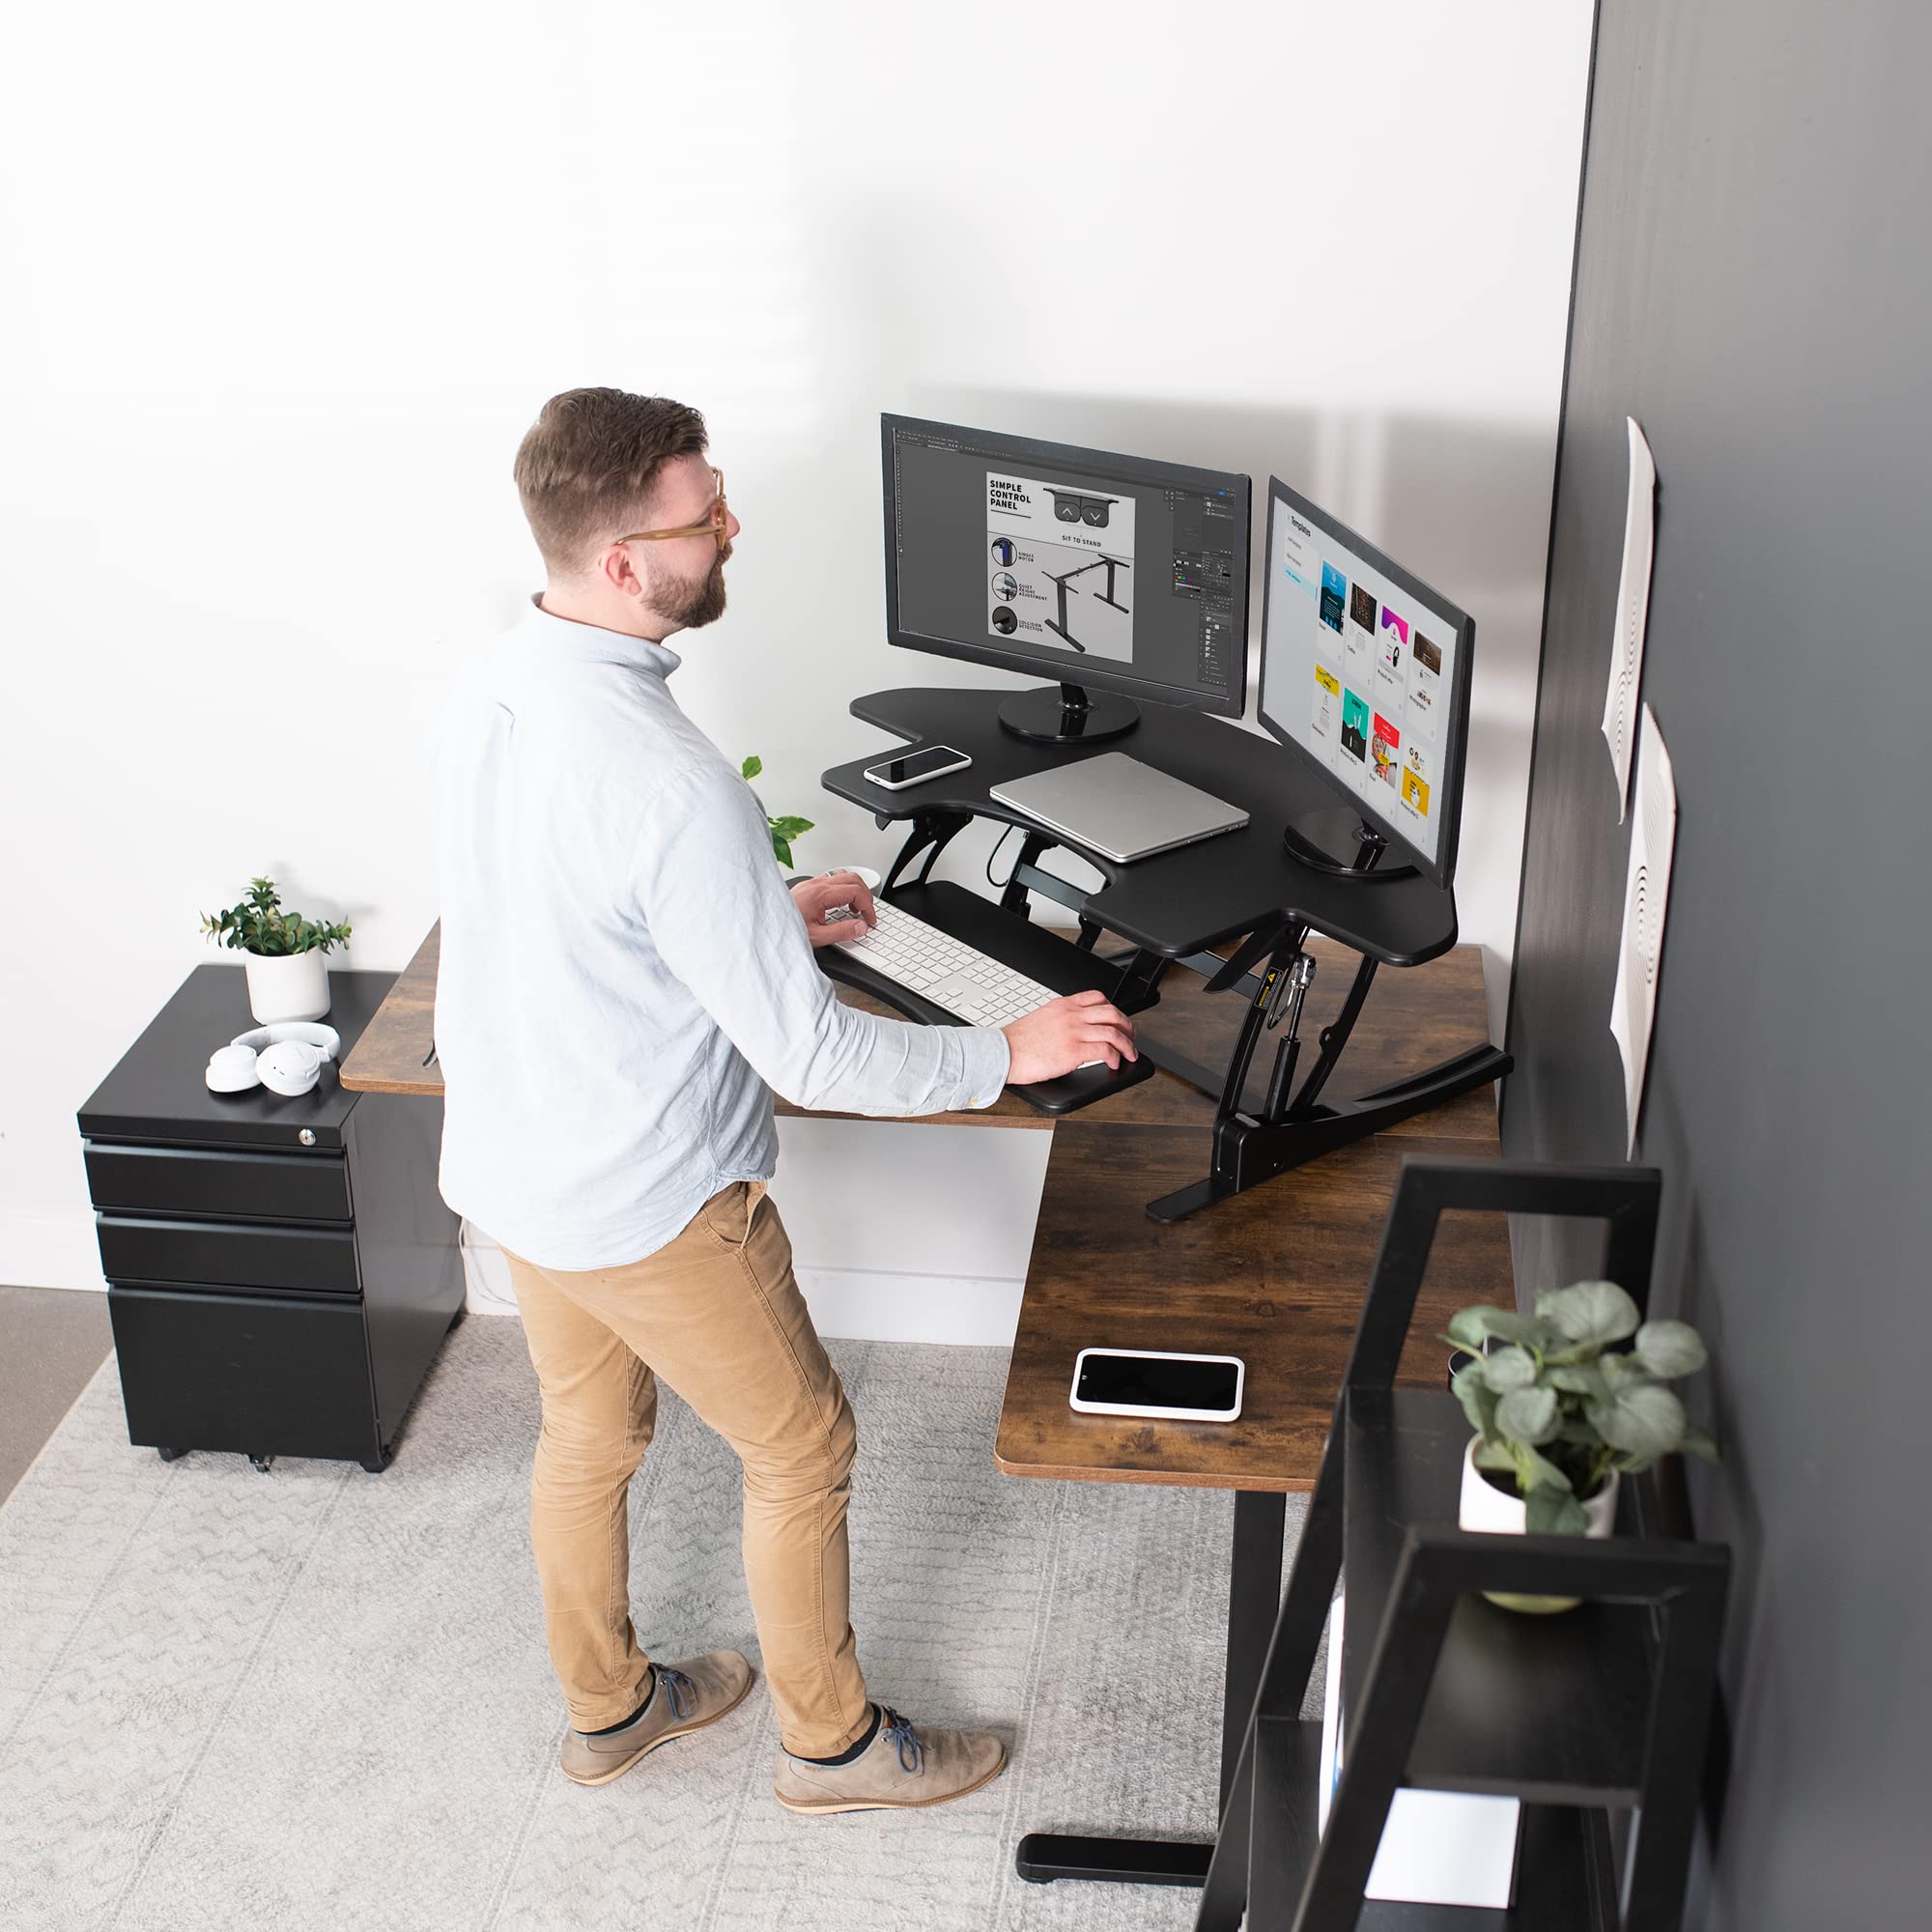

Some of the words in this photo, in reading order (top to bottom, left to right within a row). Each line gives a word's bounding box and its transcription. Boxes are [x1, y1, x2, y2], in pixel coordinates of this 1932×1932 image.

[990, 480, 1022, 493] SIMPLE
[990, 489, 1032, 503] CONTROL
[990, 497, 1018, 510] PANEL
[1292, 515, 1311, 537] Templates
[1082, 538, 1101, 548] STAND
[1019, 592, 1047, 600] ADJUSTMENT
